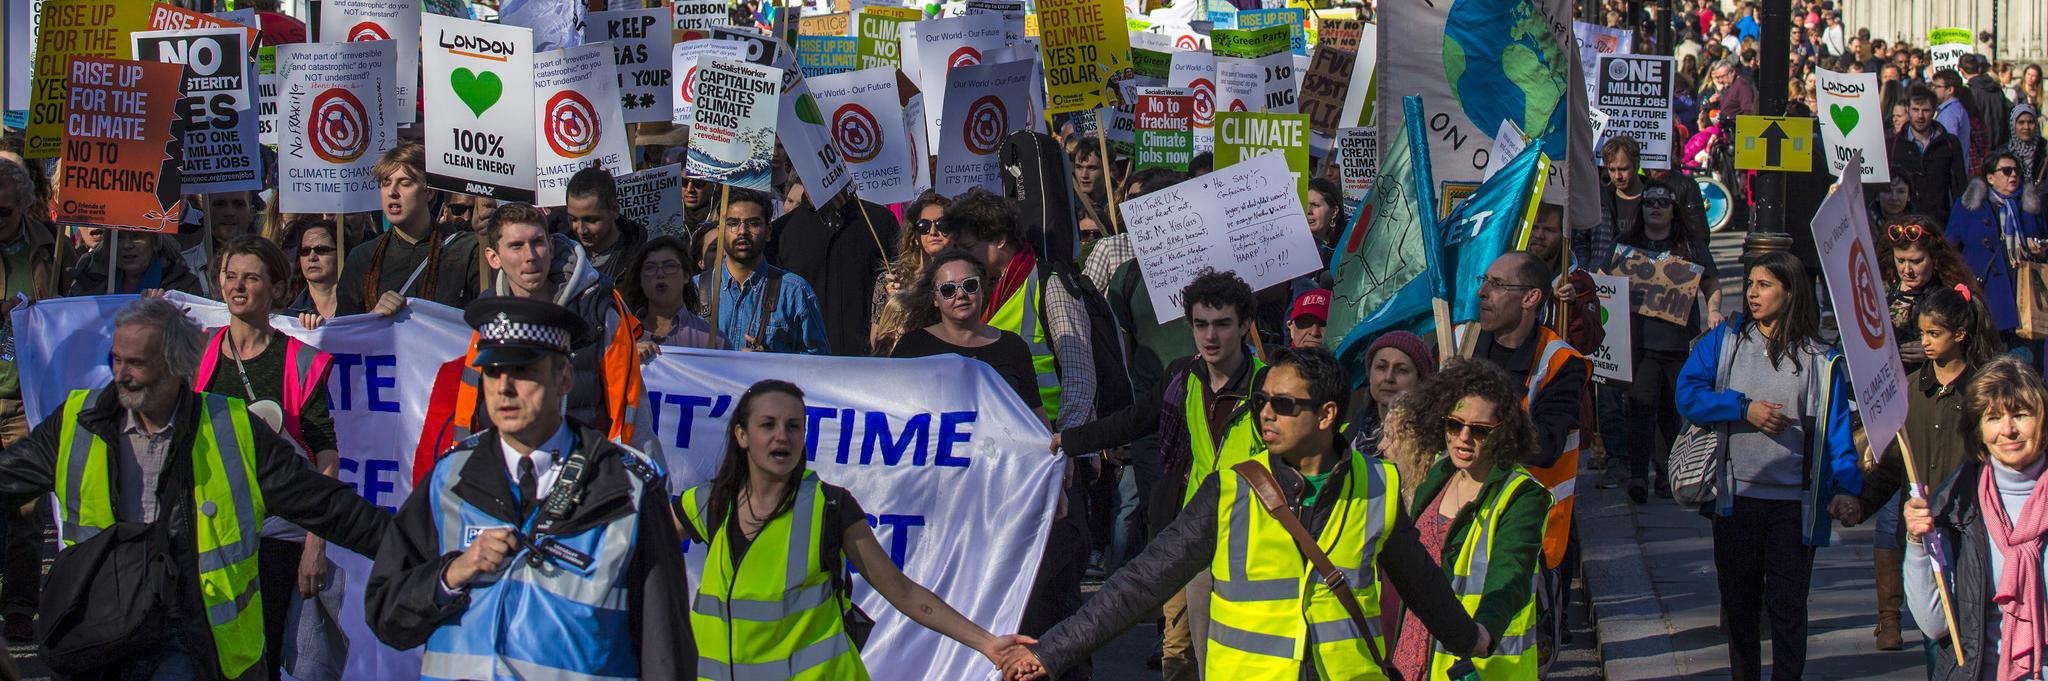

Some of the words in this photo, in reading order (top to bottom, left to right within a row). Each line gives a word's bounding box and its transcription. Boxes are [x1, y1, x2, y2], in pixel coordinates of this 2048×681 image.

[45, 5, 87, 27] RISE
[91, 4, 116, 26] UP
[344, 8, 358, 16] NOT
[361, 9, 399, 18] understand?
[677, 4, 726, 15] CARBON
[1042, 9, 1070, 29] FOR
[1075, 4, 1103, 26] THE
[677, 19, 702, 30] CUTS
[1240, 14, 1262, 26] RISE
[1264, 13, 1276, 25] UP
[1278, 12, 1297, 23] FOR
[1323, 21, 1341, 29] SAY
[1344, 22, 1359, 30] NO
[607, 15, 656, 40] KEEP
[942, 32, 962, 41] World
[981, 28, 999, 36] Future
[1318, 29, 1360, 37] CAPITALI
[42, 30, 78, 51] FOR
[83, 28, 119, 51] THE
[439, 29, 514, 56] LONDON
[1045, 24, 1106, 48] CLIMATE
[1233, 36, 1260, 46] Green
[1262, 31, 1288, 42] Party
[1320, 37, 1338, 45] SAY
[1341, 38, 1356, 46] NO
[801, 40, 822, 53] RISE
[824, 40, 836, 52] UP
[838, 41, 856, 53] FOR
[159, 37, 222, 76] NO
[291, 52, 312, 61] What
[314, 53, 329, 62] part
[330, 52, 338, 60] of
[801, 54, 819, 66] THE
[1046, 49, 1076, 68] YES
[1079, 45, 1097, 63] TO
[1315, 49, 1352, 78] FUC
[1934, 51, 1950, 61] Say
[292, 63, 307, 71] and
[358, 61, 367, 69] do
[369, 61, 382, 71] you
[540, 60, 554, 71] part
[555, 58, 563, 67] of
[580, 61, 590, 71] do
[590, 60, 602, 72] you
[1186, 63, 1202, 71] World
[1275, 65, 1291, 80] to
[72, 60, 114, 87] RISE
[118, 64, 144, 89] UP
[305, 73, 322, 81] NOT
[325, 71, 370, 82] understand?
[535, 80, 551, 89] NOT
[552, 72, 593, 87] understand?
[632, 69, 671, 87] YOUR
[700, 69, 776, 95] CAPITALISM
[1051, 65, 1099, 86] SOLAR
[824, 88, 846, 98] World
[851, 86, 866, 95] Our
[868, 82, 892, 93] Future
[953, 80, 966, 89] Our
[967, 78, 990, 88] World
[1305, 74, 1347, 98] SYST
[1608, 82, 1661, 96] MILLION
[1822, 77, 1865, 93] LONDON
[70, 87, 107, 112] FOR
[111, 91, 147, 115] THE
[698, 82, 756, 106] CREATES
[1601, 96, 1641, 106] CLIMATE
[1643, 97, 1667, 107] JOBS
[185, 93, 239, 131] ES
[696, 96, 752, 118] CLIMATE
[1149, 98, 1163, 113] No
[1167, 98, 1180, 113] to
[695, 110, 738, 129] CHAOS
[1622, 109, 1629, 117] A
[1631, 110, 1667, 119] FUTURE
[68, 113, 146, 141] CLIMATE
[694, 122, 708, 132] One
[709, 127, 736, 138] solution
[1140, 114, 1188, 132] fracking
[1607, 119, 1632, 128] THAT
[1633, 120, 1659, 129] DOES
[188, 131, 206, 145] TO
[210, 130, 240, 143] ONE
[1142, 130, 1186, 148] Climate
[1221, 117, 1303, 147] CLIMATE
[1649, 132, 1667, 140] THE
[188, 144, 243, 158] MILLION
[453, 128, 505, 159] 100%
[66, 141, 92, 162] NO
[96, 142, 119, 164] TO
[1138, 148, 1163, 165] jobs
[1166, 151, 1189, 164] now
[216, 156, 250, 169] JOBS
[443, 153, 474, 170] CLEAN
[477, 158, 516, 177] ENERGY
[536, 163, 576, 177] CLIMATE
[944, 164, 981, 174] CLIMATE
[64, 166, 154, 194] FRACKING
[289, 168, 337, 179] CLIMATE
[945, 174, 961, 184] IT'S
[962, 174, 984, 184] TIME
[985, 173, 996, 183] TO
[292, 182, 312, 193] IT'S
[315, 182, 341, 193] TIME
[344, 182, 359, 192] TO
[539, 178, 556, 189] IT'S
[616, 176, 677, 198] APITALISM
[866, 181, 881, 191] TO
[616, 191, 661, 209] REATES
[1831, 216, 1849, 241] World
[1862, 363, 1891, 406] CLIMATE
[1882, 381, 1898, 413] TIME
[646, 391, 732, 449] IT'
[806, 405, 977, 467] TIME
